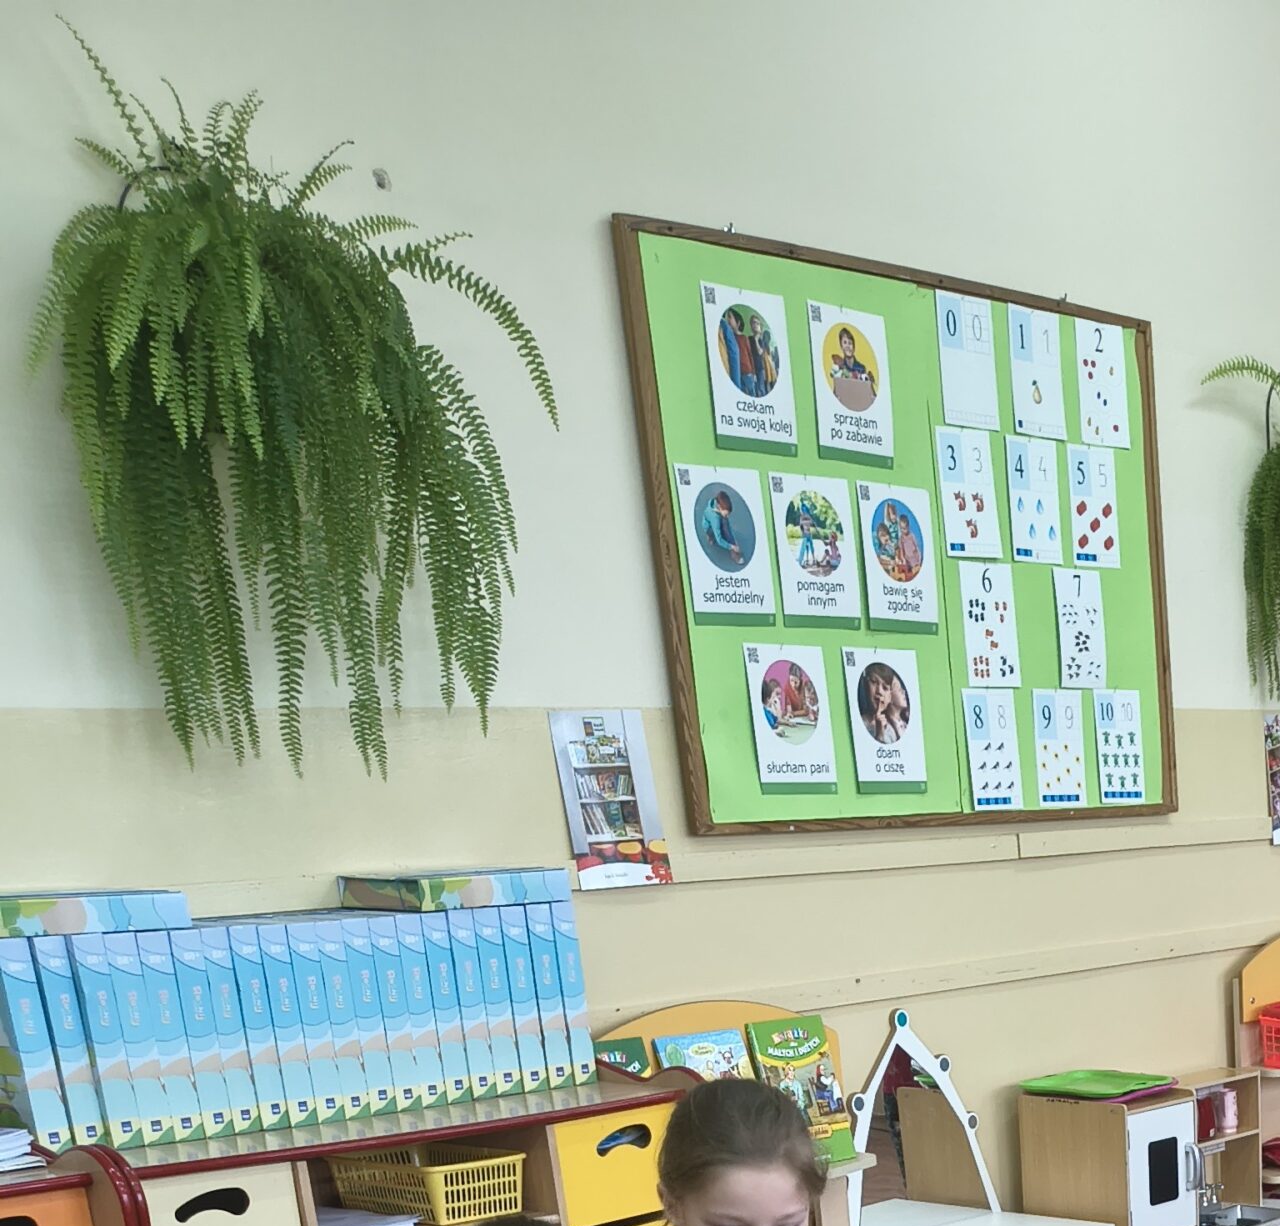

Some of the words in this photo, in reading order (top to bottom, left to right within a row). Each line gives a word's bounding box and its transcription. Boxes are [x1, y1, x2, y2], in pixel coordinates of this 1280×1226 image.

[945, 309, 957, 336] 0
[1018, 323, 1026, 350] 1
[1093, 327, 1104, 353] 2
[736, 400, 775, 415] czekam
[720, 413, 734, 426] na
[737, 417, 768, 433] swoją
[769, 418, 793, 437] kolej
[833, 412, 878, 431] sprzątam
[830, 427, 843, 440] po
[845, 429, 883, 446] zabawie
[947, 444, 957, 471] 3
[1014, 454, 1024, 479] 4
[1076, 460, 1086, 485] 5
[715, 575, 750, 588] jestem
[797, 580, 845, 596] pomagam
[981, 568, 993, 593] 6
[1072, 574, 1081, 598] 7
[703, 591, 765, 606] samodzielny
[807, 594, 837, 608] innym
[883, 584, 908, 599] bawię
[911, 587, 923, 601] się
[887, 600, 921, 613] zgodnie
[973, 704, 984, 729] 8
[1041, 705, 1051, 729] 9
[1099, 702, 1114, 722] 10
[876, 747, 901, 759] dbam
[767, 761, 807, 774] słucham
[810, 762, 830, 776] pani
[875, 763, 882, 773] o
[883, 762, 905, 775] ciszę
